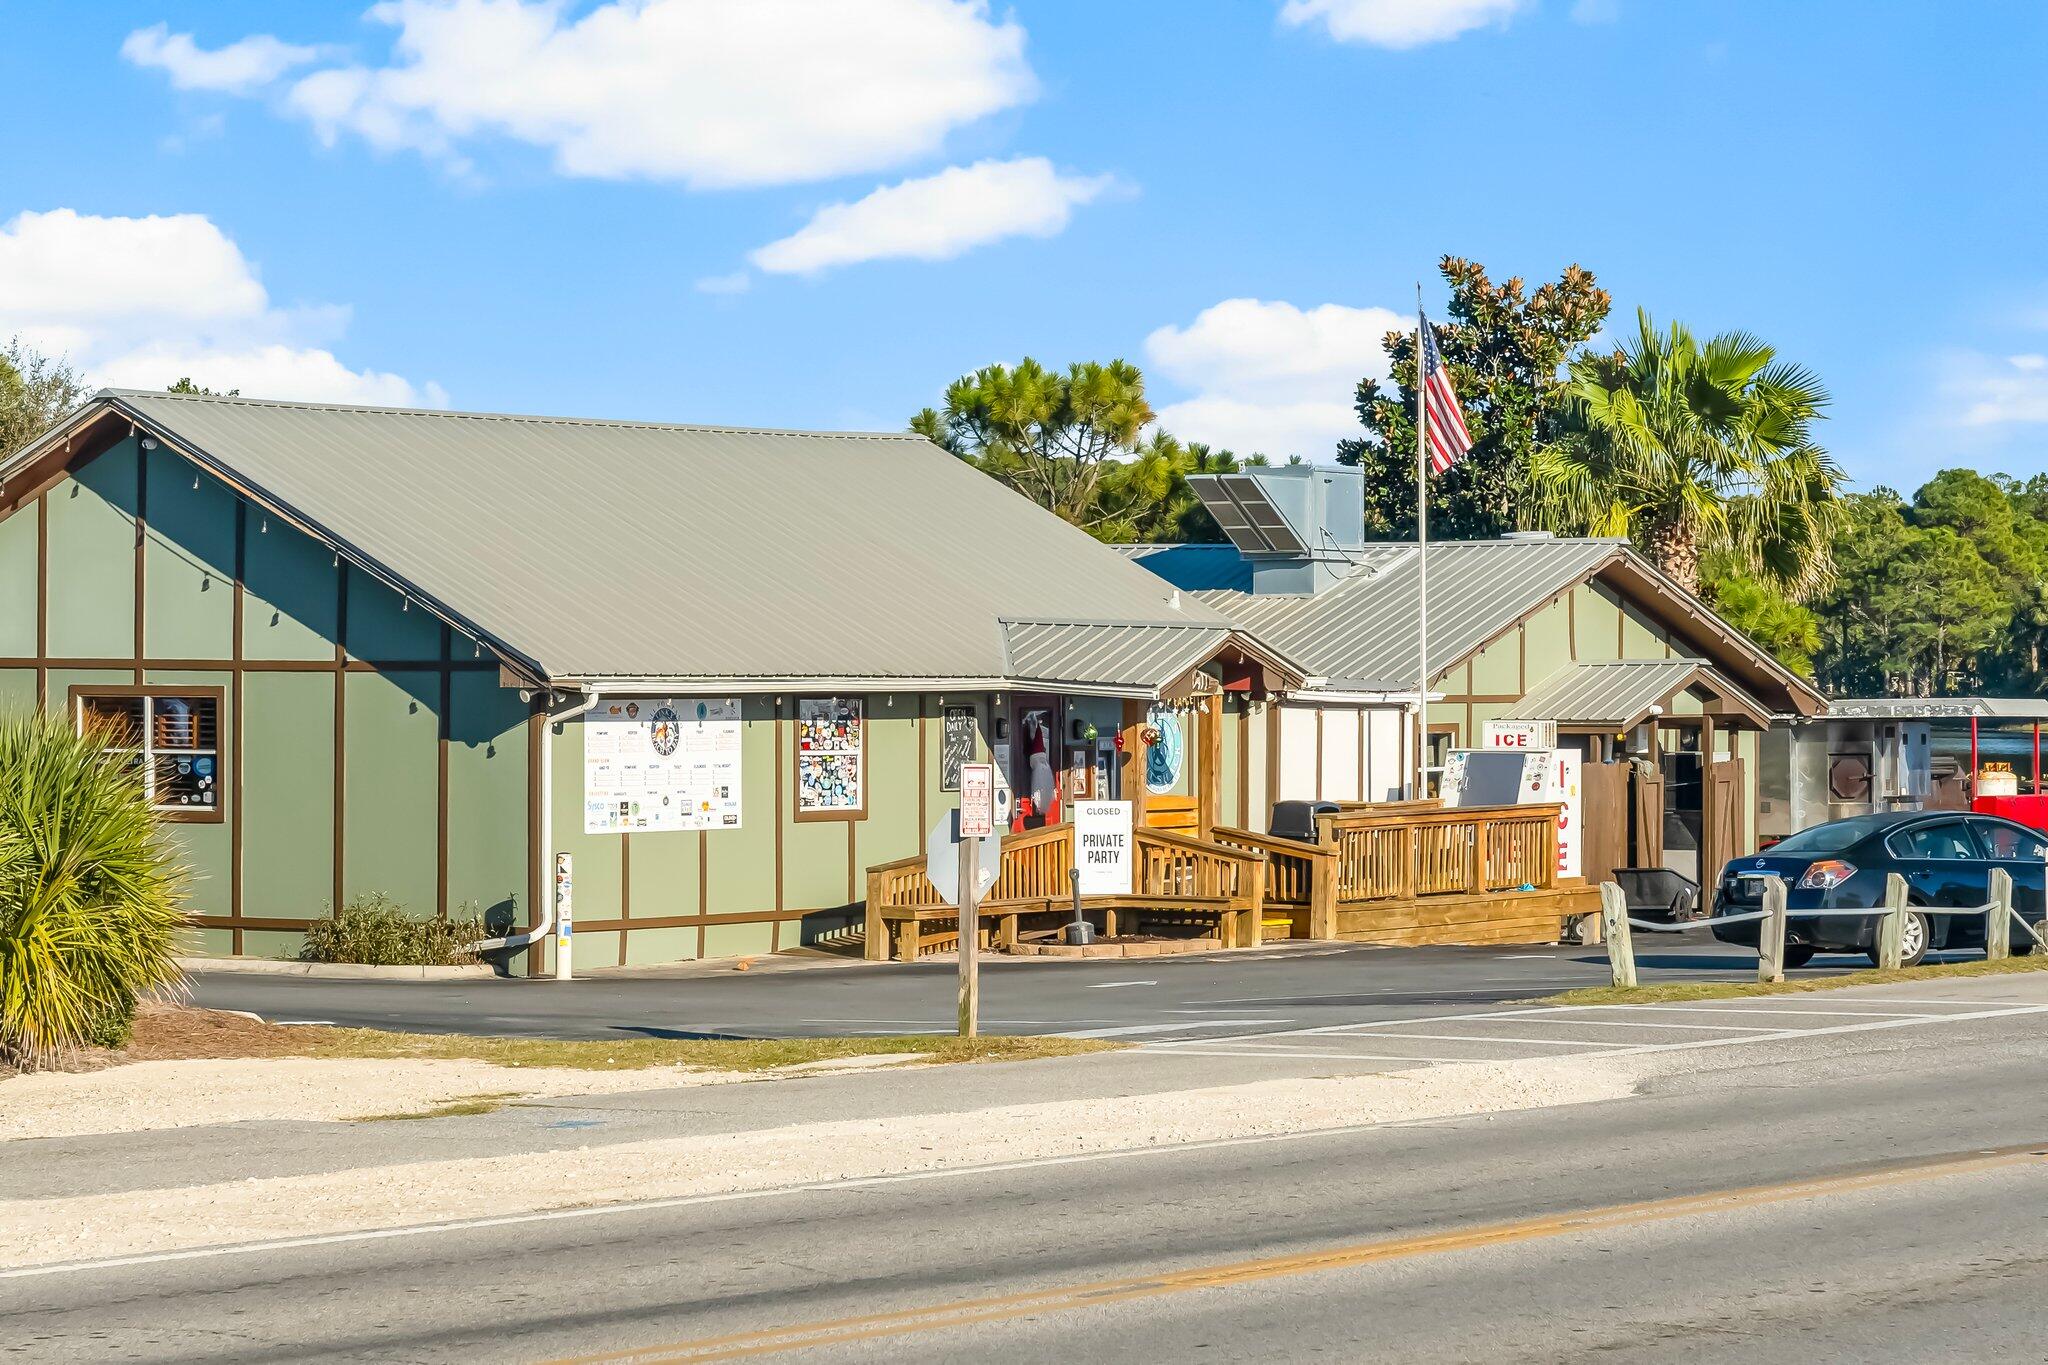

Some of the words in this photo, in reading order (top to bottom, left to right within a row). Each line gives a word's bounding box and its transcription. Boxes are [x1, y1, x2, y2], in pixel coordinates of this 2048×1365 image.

[946, 721, 963, 733] DAILY
[1492, 722, 1530, 731] Packaged
[1495, 733, 1527, 747] ICE
[1086, 807, 1121, 816] CLOSED
[1083, 834, 1125, 848] PRIVATE
[1087, 850, 1120, 864] PARTY
